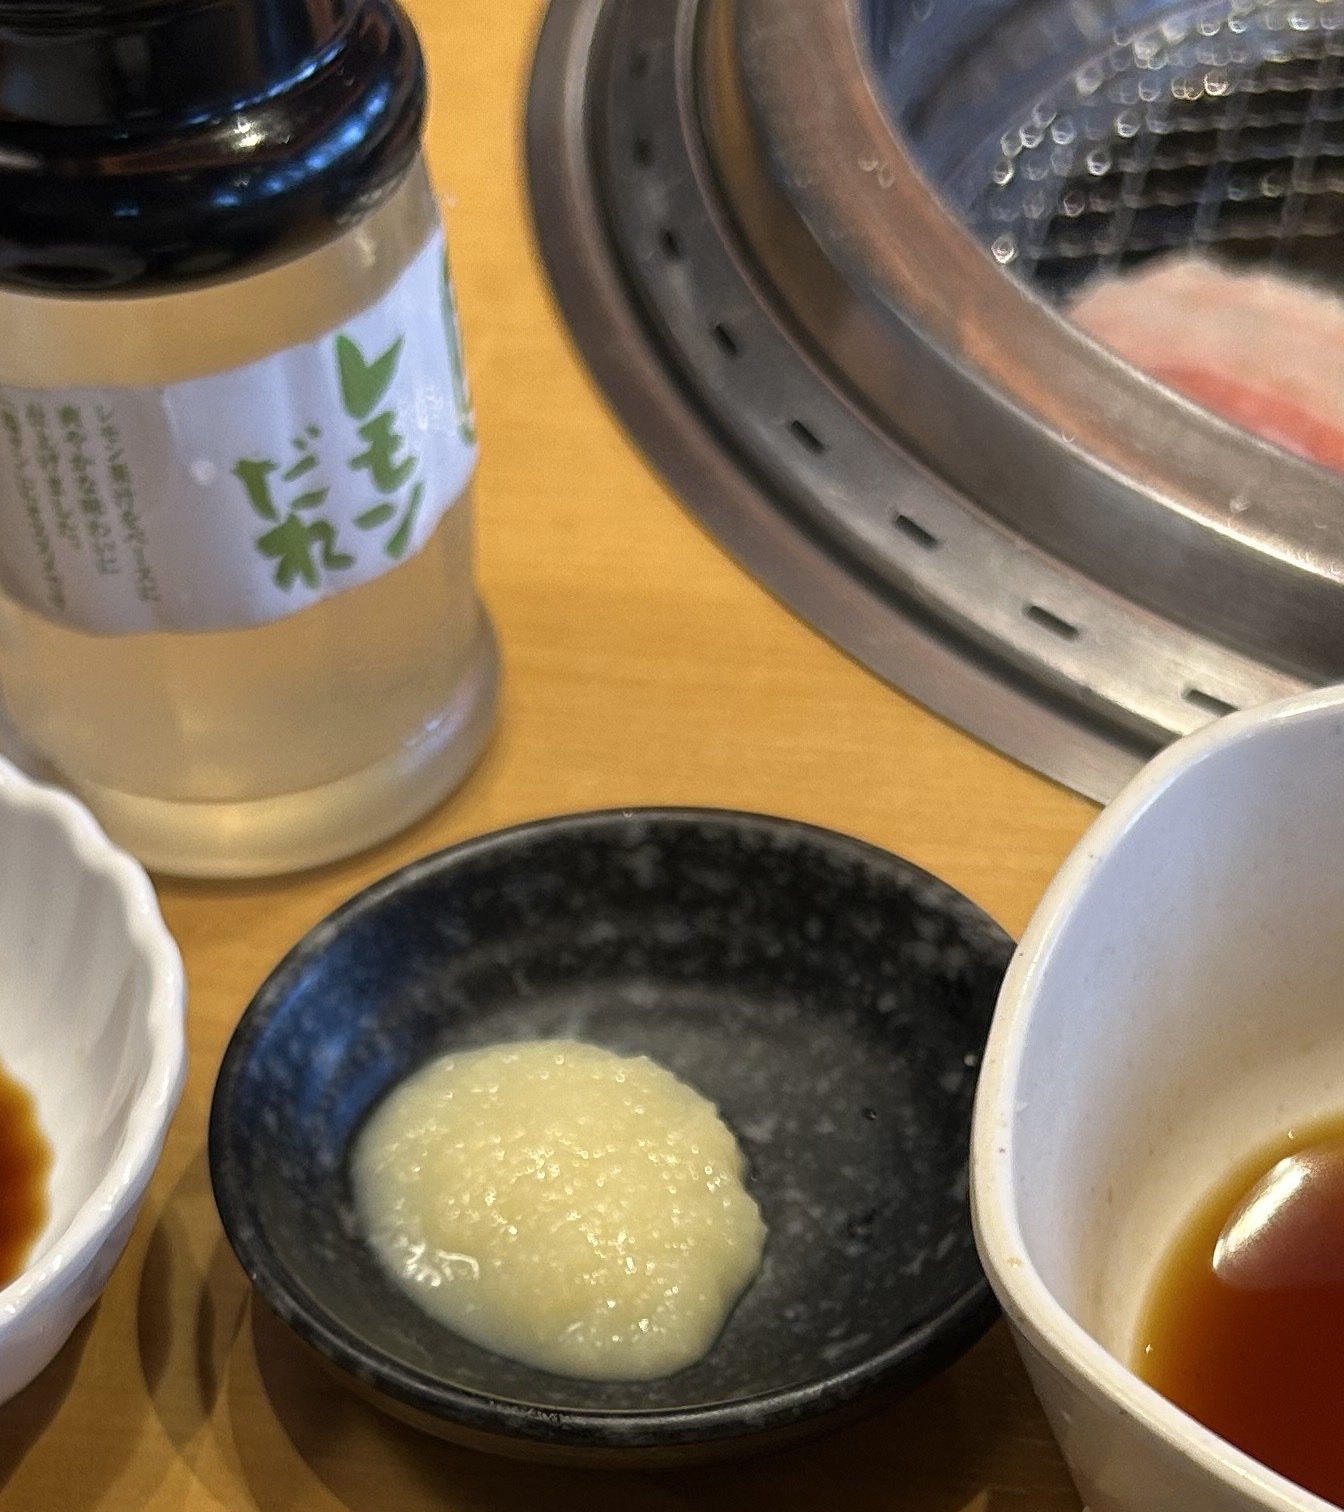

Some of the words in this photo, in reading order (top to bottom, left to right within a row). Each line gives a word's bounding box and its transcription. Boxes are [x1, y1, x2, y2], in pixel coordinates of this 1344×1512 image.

[233, 424, 355, 592] だれ
[333, 332, 424, 561] レモン
